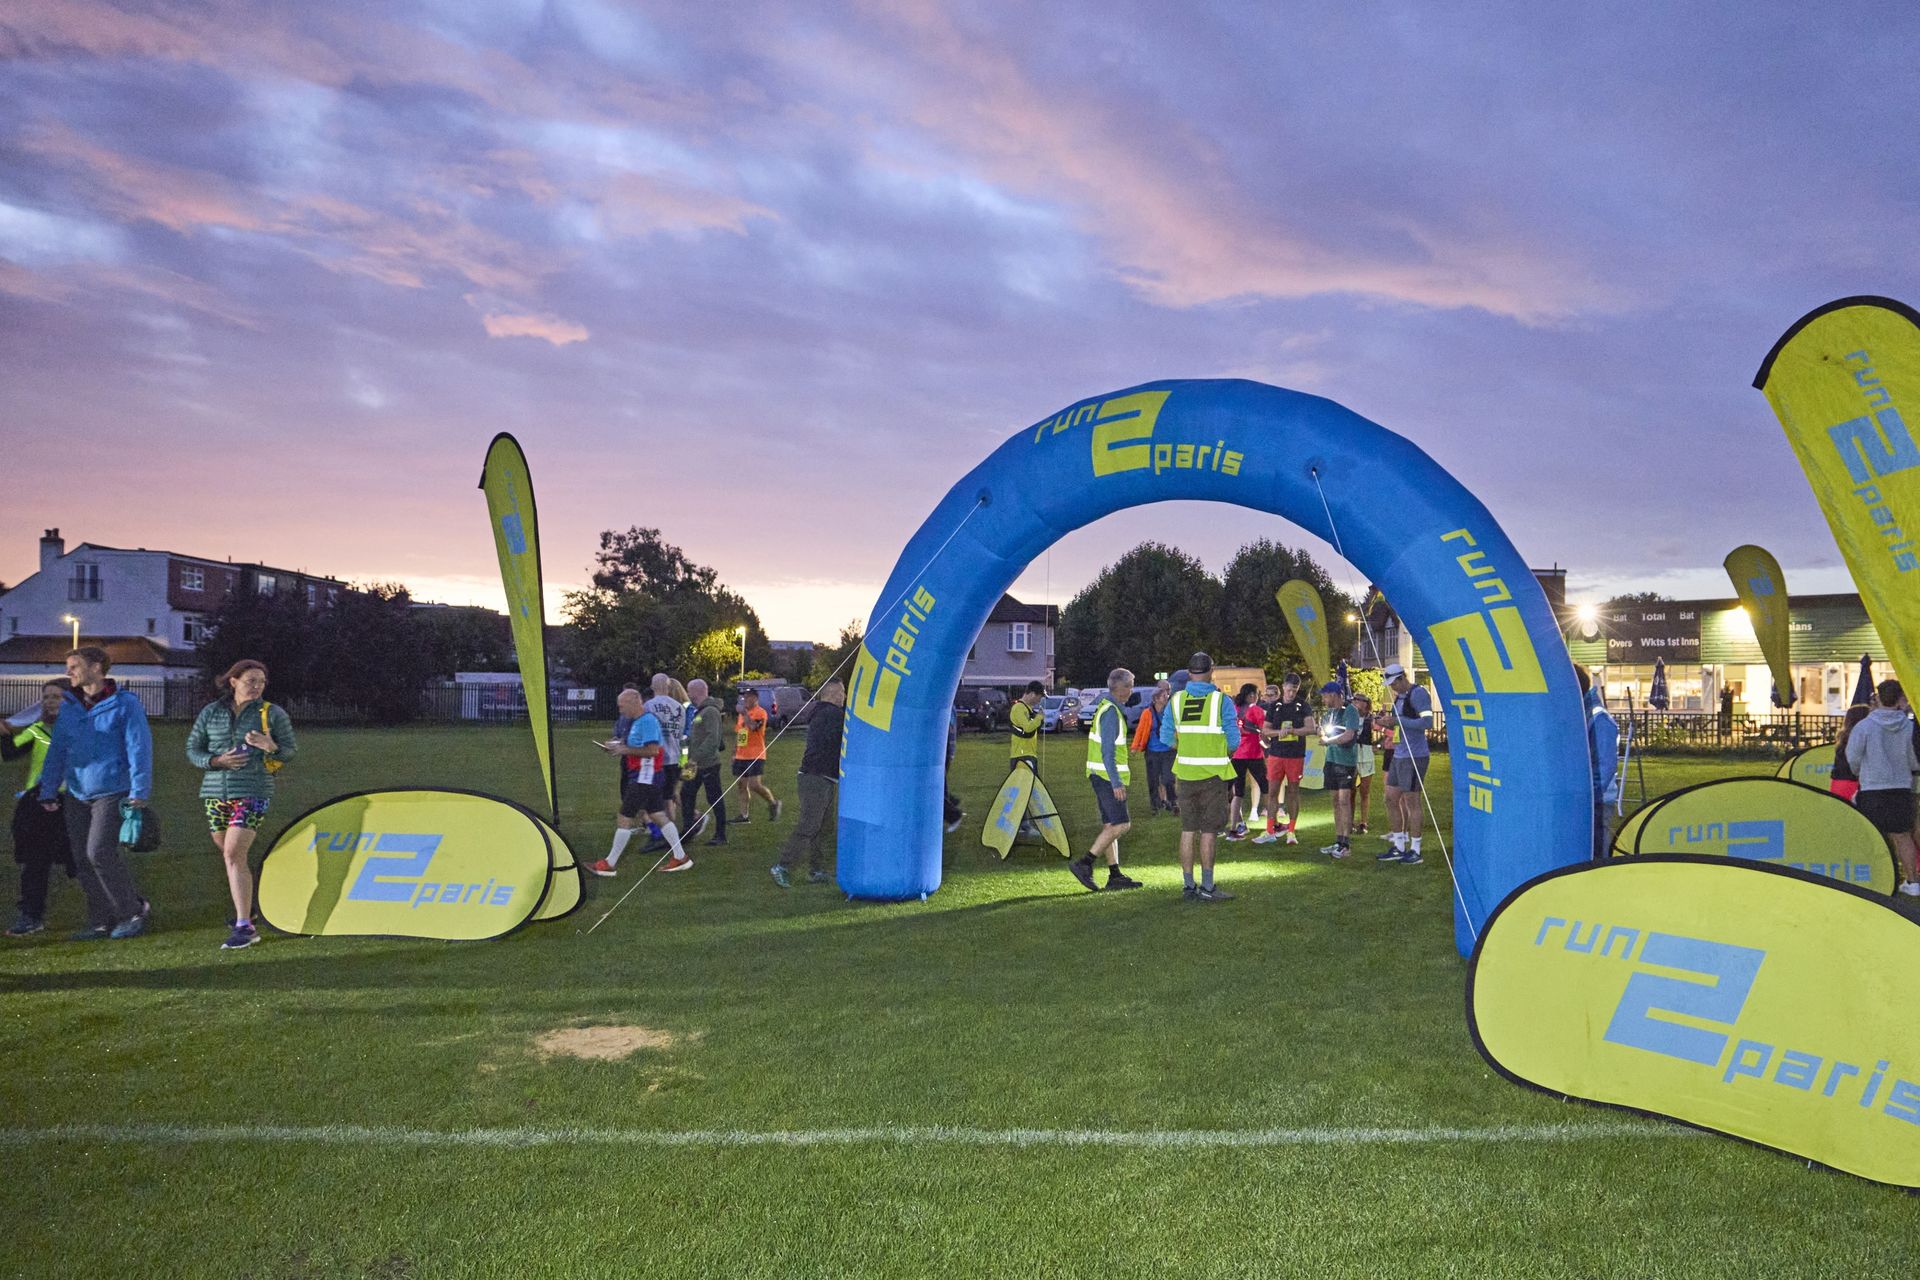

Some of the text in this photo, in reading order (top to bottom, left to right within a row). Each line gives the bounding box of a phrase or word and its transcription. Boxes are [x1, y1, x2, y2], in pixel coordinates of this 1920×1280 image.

[1034, 390, 1244, 478] run 2 paris
[1827, 349, 1920, 573] run 2 paris
[885, 585, 936, 676] paris
[1642, 612, 1666, 621] Total
[1667, 637, 1700, 646] 1st Inns
[1609, 638, 1633, 648] Overs
[1641, 638, 1665, 647] Wkts
[1427, 528, 1549, 814] run 2 paris
[1181, 698, 1207, 722] 2
[1668, 822, 1723, 846] run
[308, 832, 515, 909] run 2 paris
[1535, 916, 1920, 1127] run 2 paris
